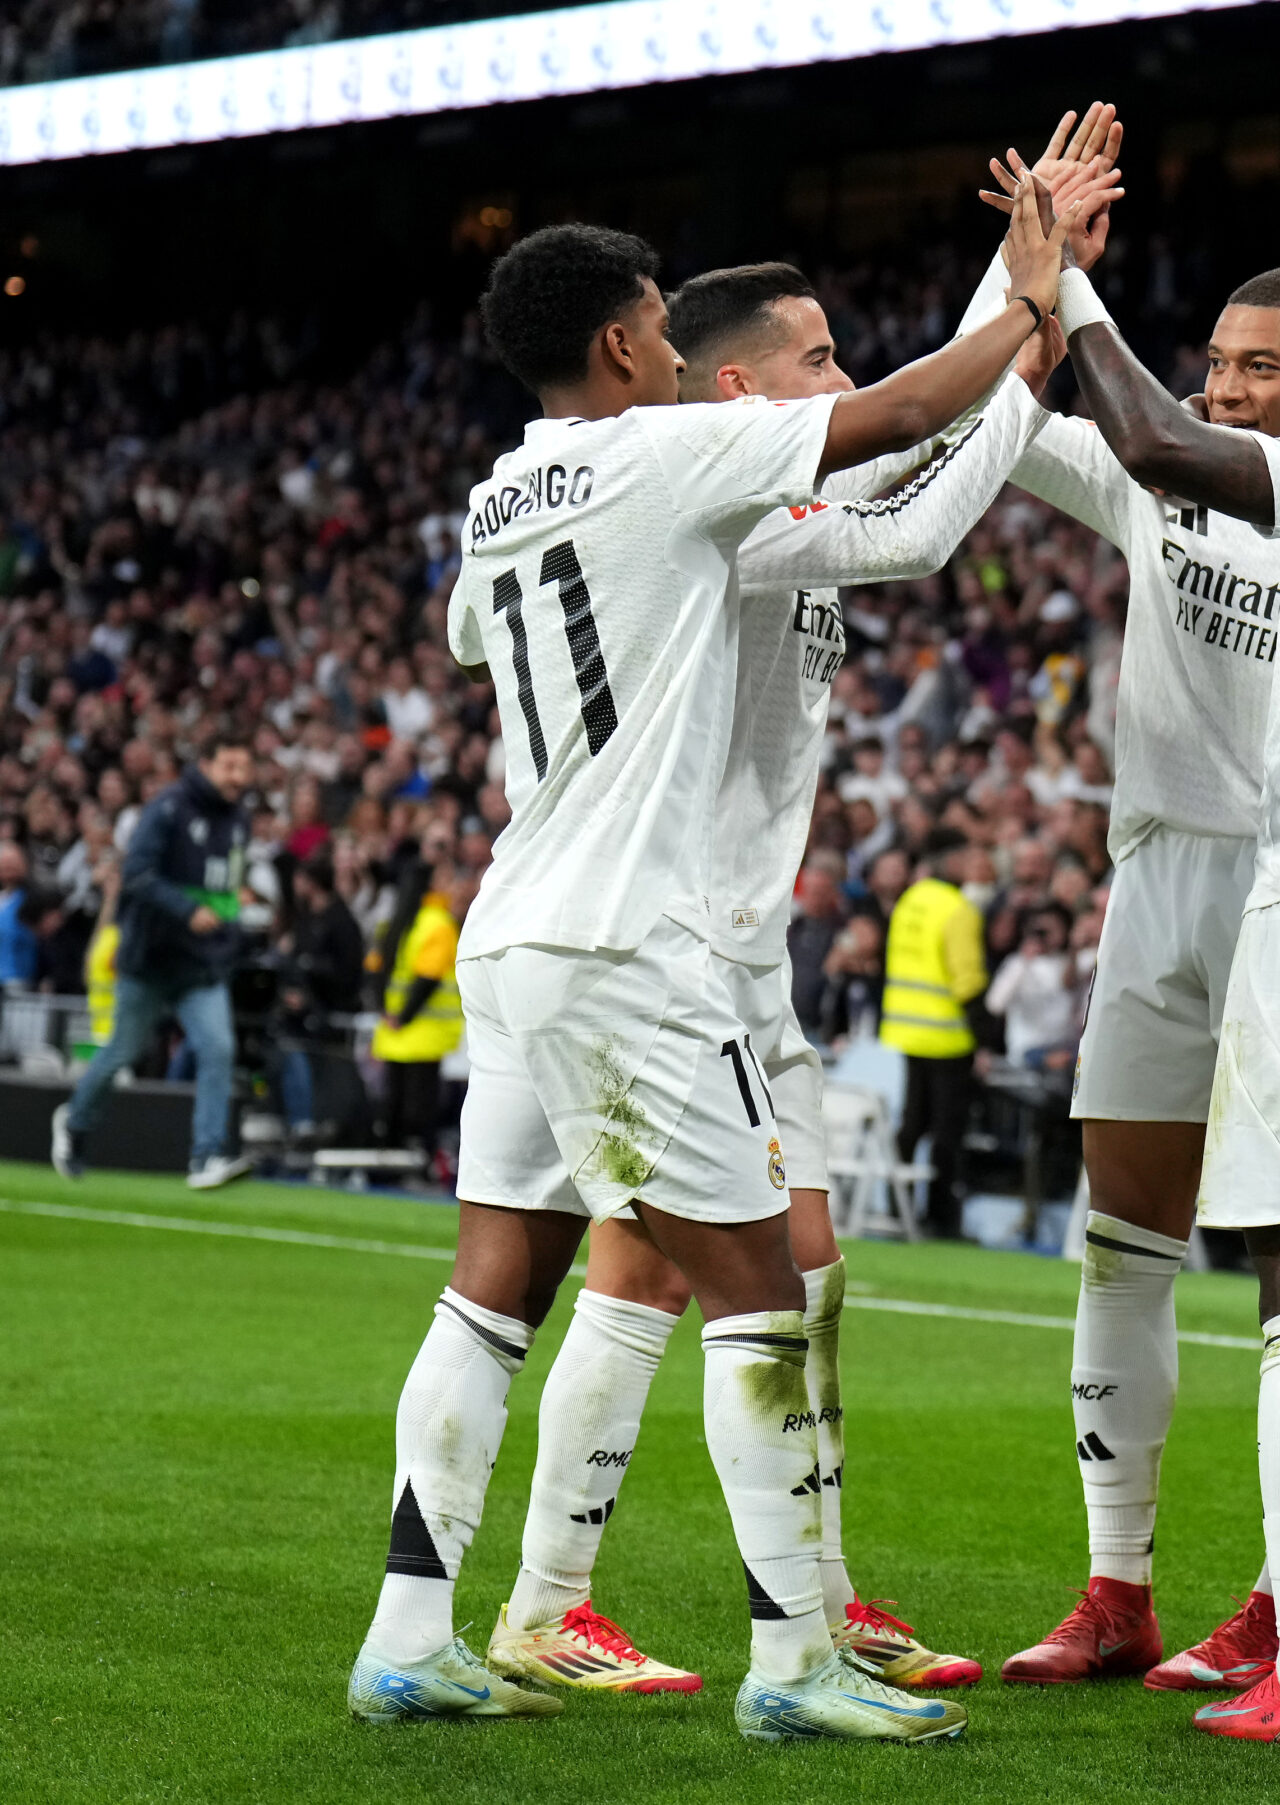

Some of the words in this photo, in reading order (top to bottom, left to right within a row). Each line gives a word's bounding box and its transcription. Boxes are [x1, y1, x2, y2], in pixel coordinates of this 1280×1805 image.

[1176, 596, 1204, 635] FLY
[492, 538, 618, 784] 11
[802, 644, 824, 680] FLY
[1071, 1383, 1118, 1401] MCF
